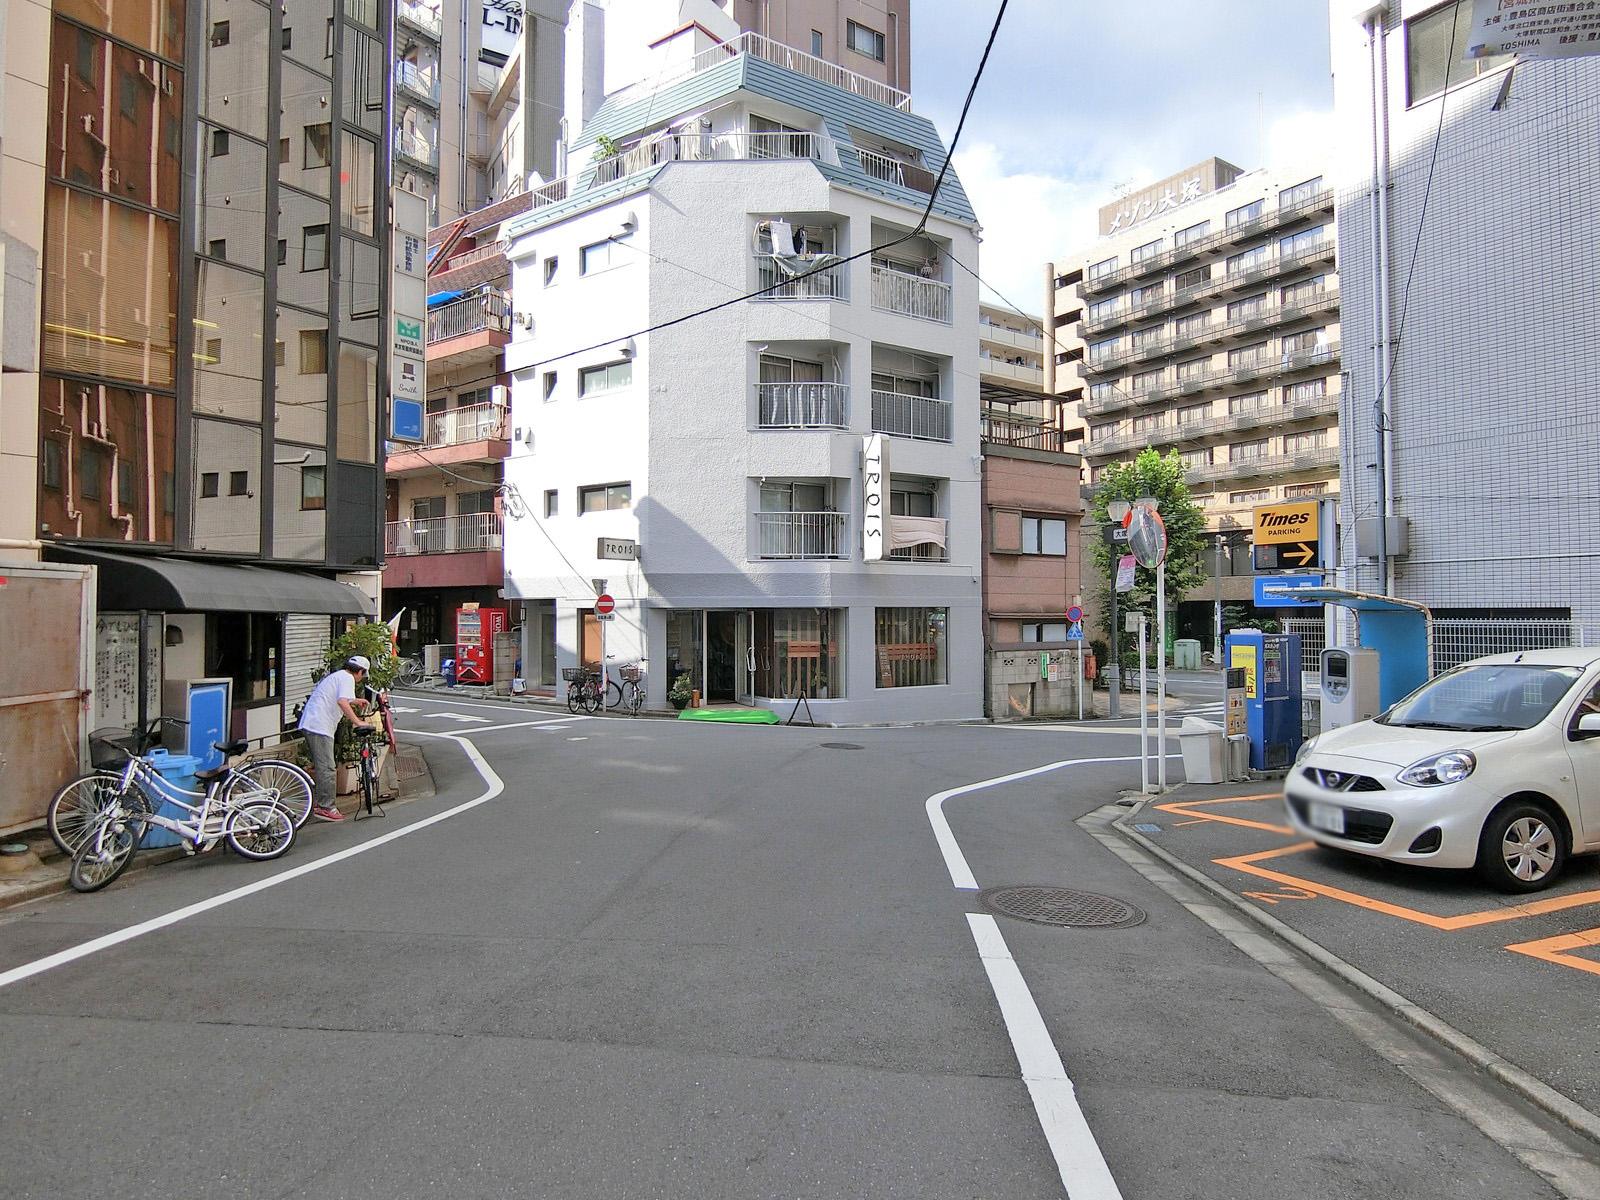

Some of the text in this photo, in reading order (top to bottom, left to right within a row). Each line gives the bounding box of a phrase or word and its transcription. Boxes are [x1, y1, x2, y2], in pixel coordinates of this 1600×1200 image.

[1500, 38, 1541, 51] TOSHIMA
[1108, 176, 1205, 235] メゾン大塚
[398, 383, 418, 394] Smith
[865, 455, 881, 537] TROIS
[1259, 512, 1310, 527] Times
[1267, 527, 1301, 536] PARKING
[606, 544, 633, 554] TROIS
